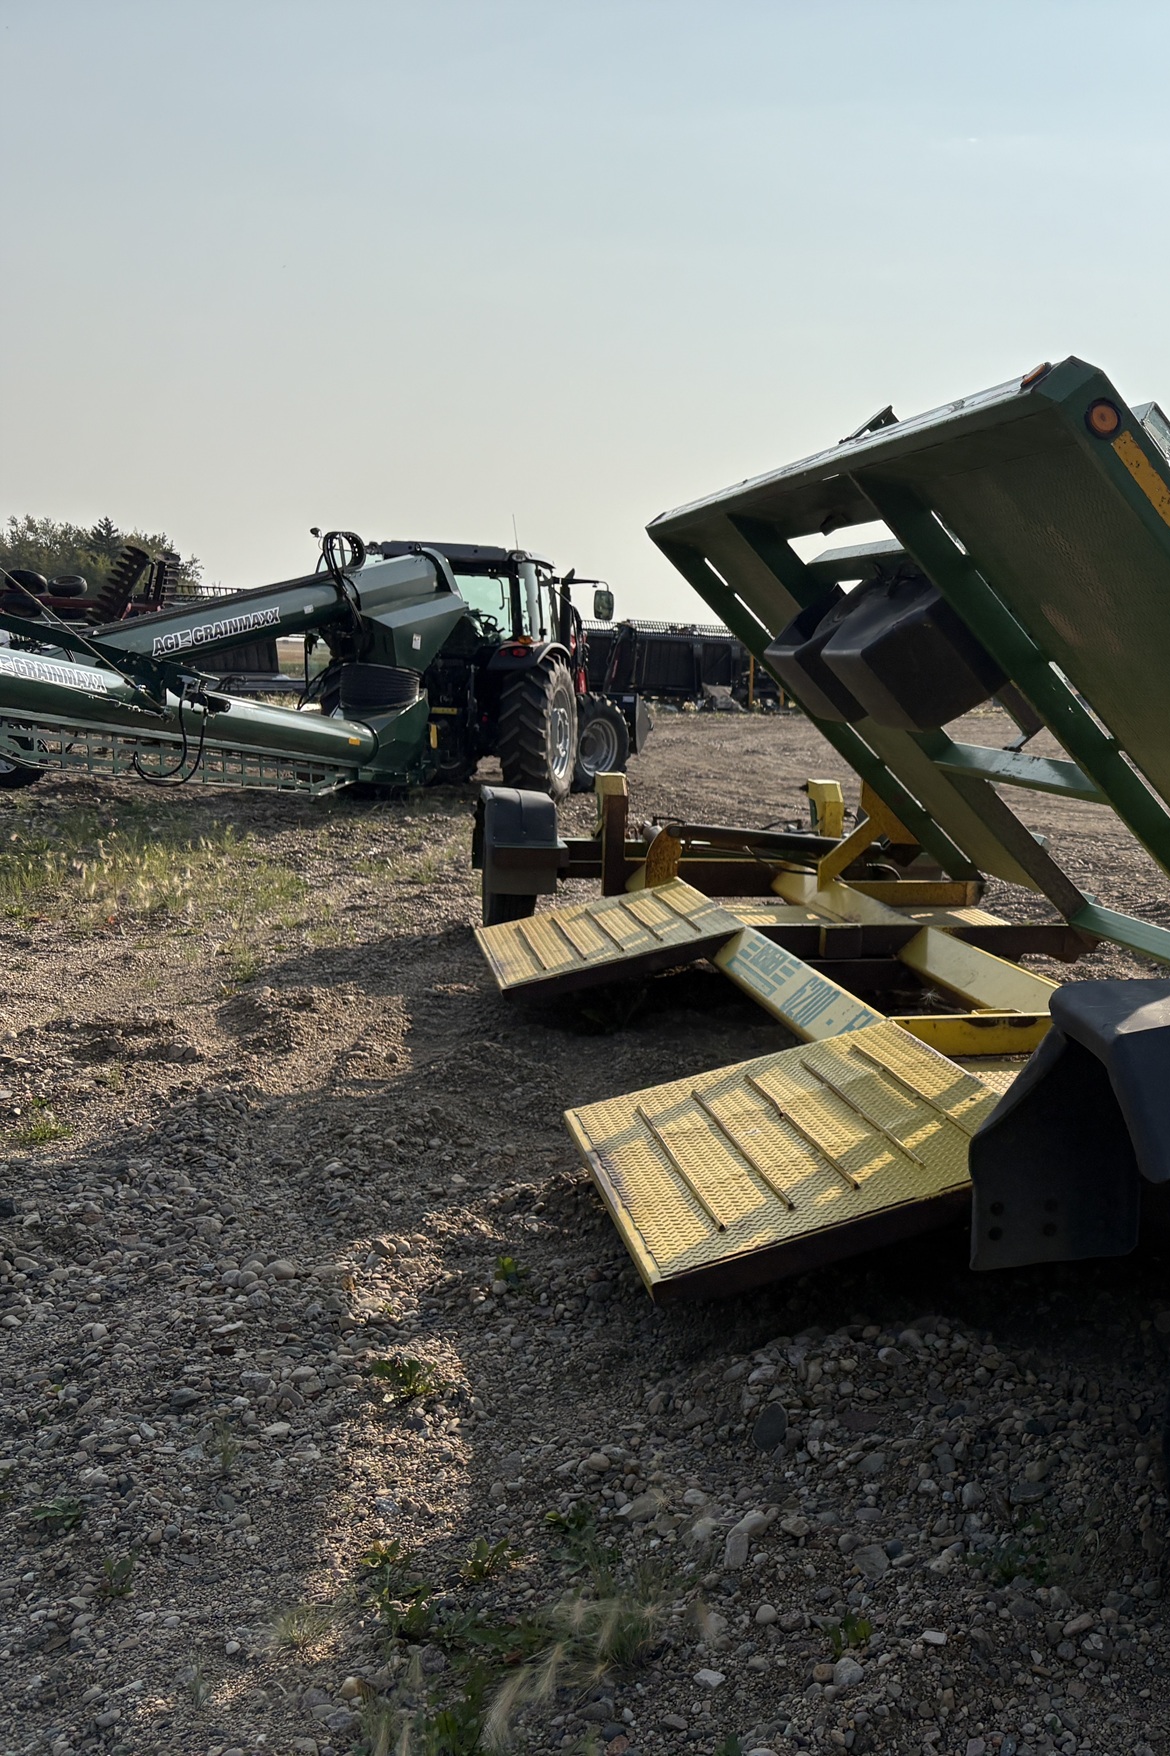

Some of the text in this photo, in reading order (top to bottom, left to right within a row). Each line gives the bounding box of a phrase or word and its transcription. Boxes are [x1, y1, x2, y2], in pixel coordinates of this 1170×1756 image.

[152, 607, 281, 656] AGI GRAINMAXX
[13, 657, 107, 693] GRAINMAXX
[779, 976, 841, 1028] 6200
